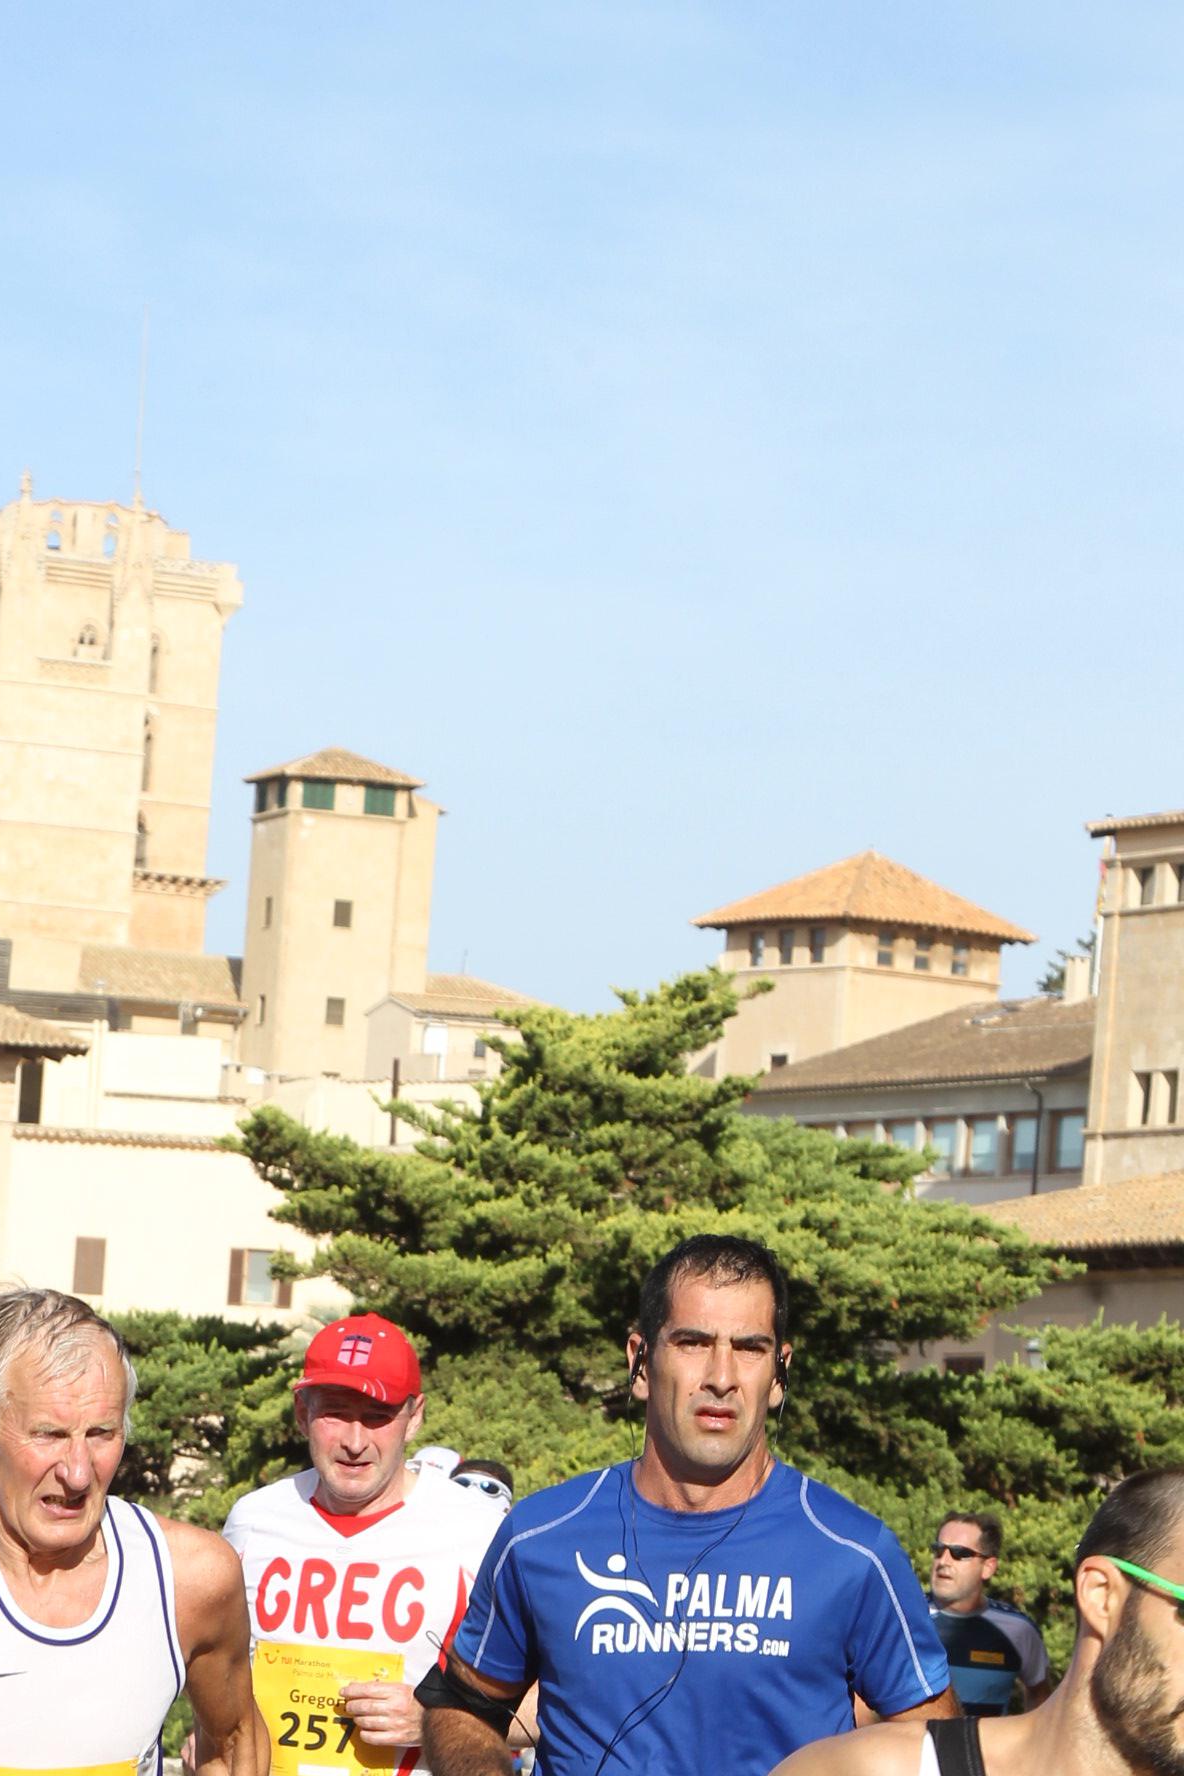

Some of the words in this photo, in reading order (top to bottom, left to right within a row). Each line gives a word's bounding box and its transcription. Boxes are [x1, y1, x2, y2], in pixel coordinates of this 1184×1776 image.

[256, 1557, 426, 1643] GREG
[665, 1573, 793, 1620] PALMA
[294, 1659, 331, 1668] Marathon
[278, 1711, 357, 1754] 257
